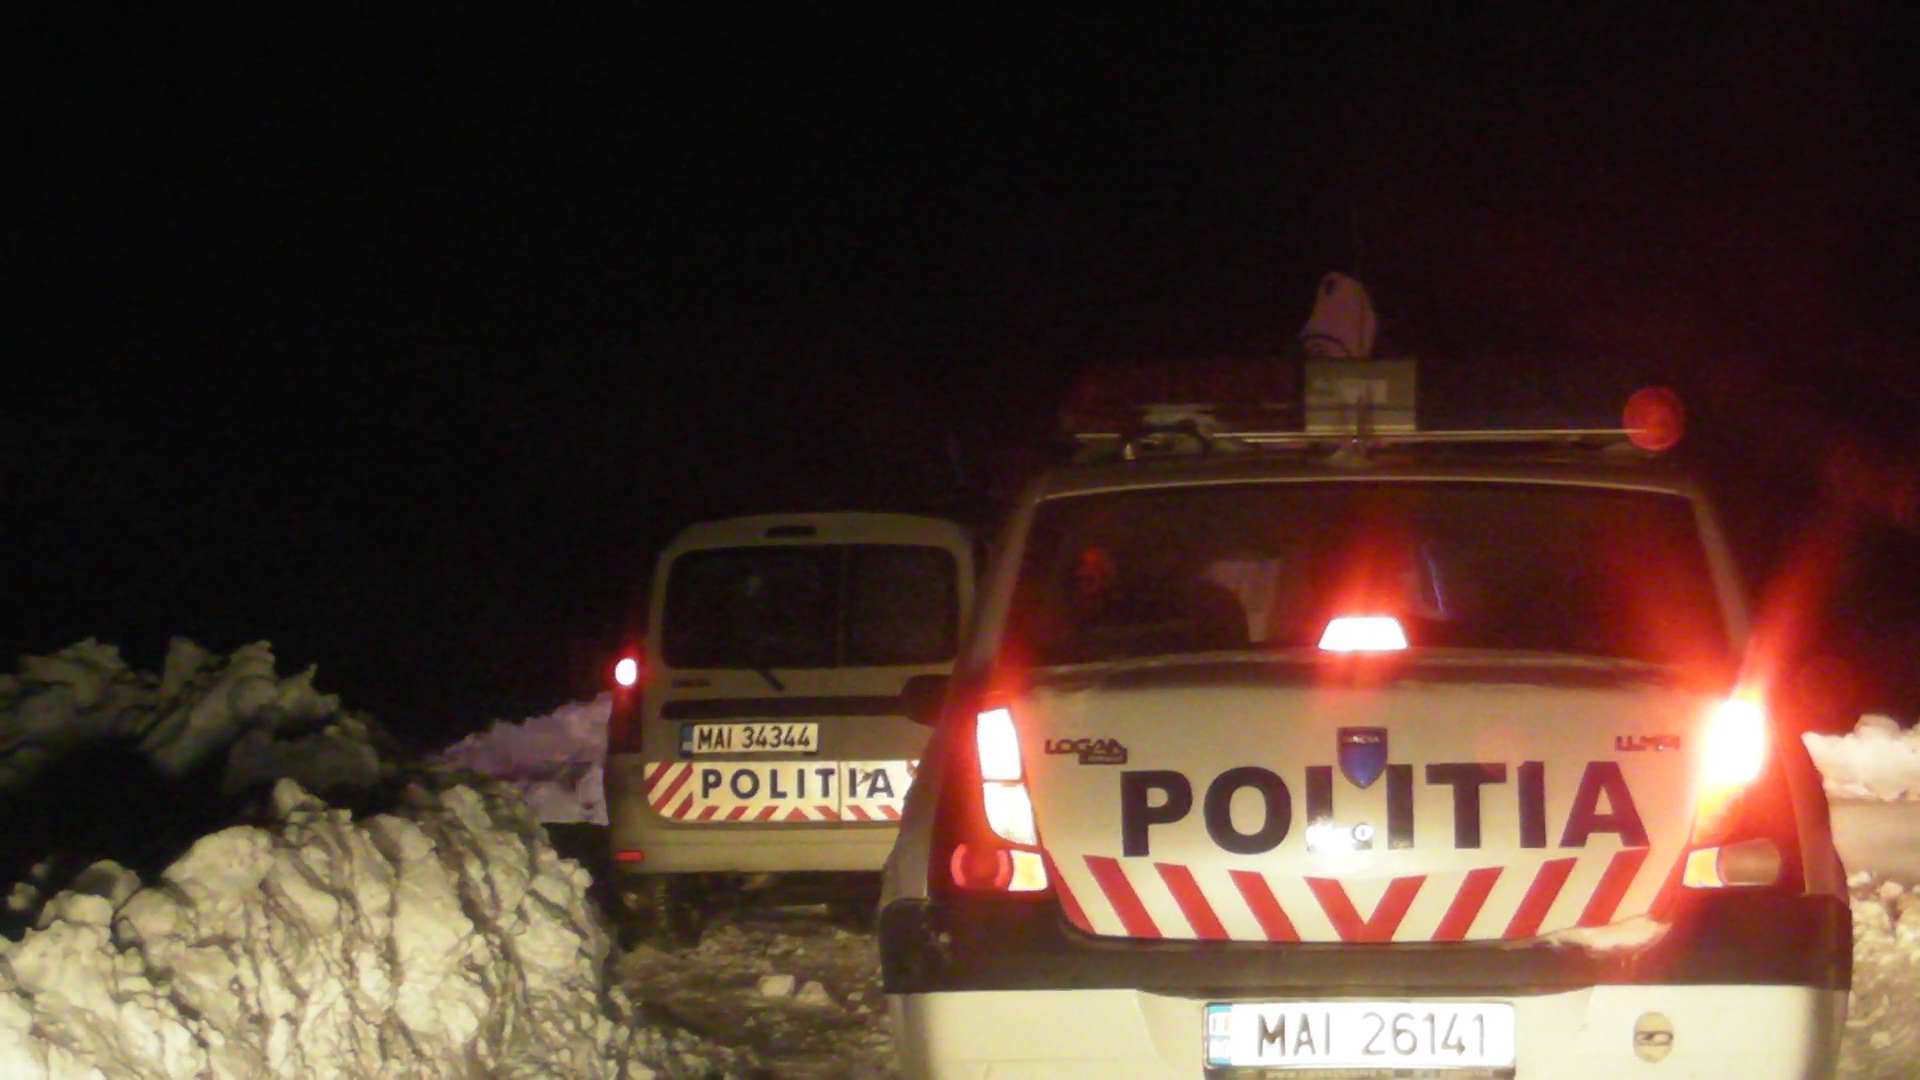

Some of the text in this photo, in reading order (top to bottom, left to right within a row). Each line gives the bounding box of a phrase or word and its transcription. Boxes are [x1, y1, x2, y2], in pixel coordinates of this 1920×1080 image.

[698, 725, 810, 750] MAI 34344
[702, 768, 894, 799] POLITIA
[1120, 761, 1650, 857] POLITIA
[1256, 1012, 1486, 1058] MAI 26141
